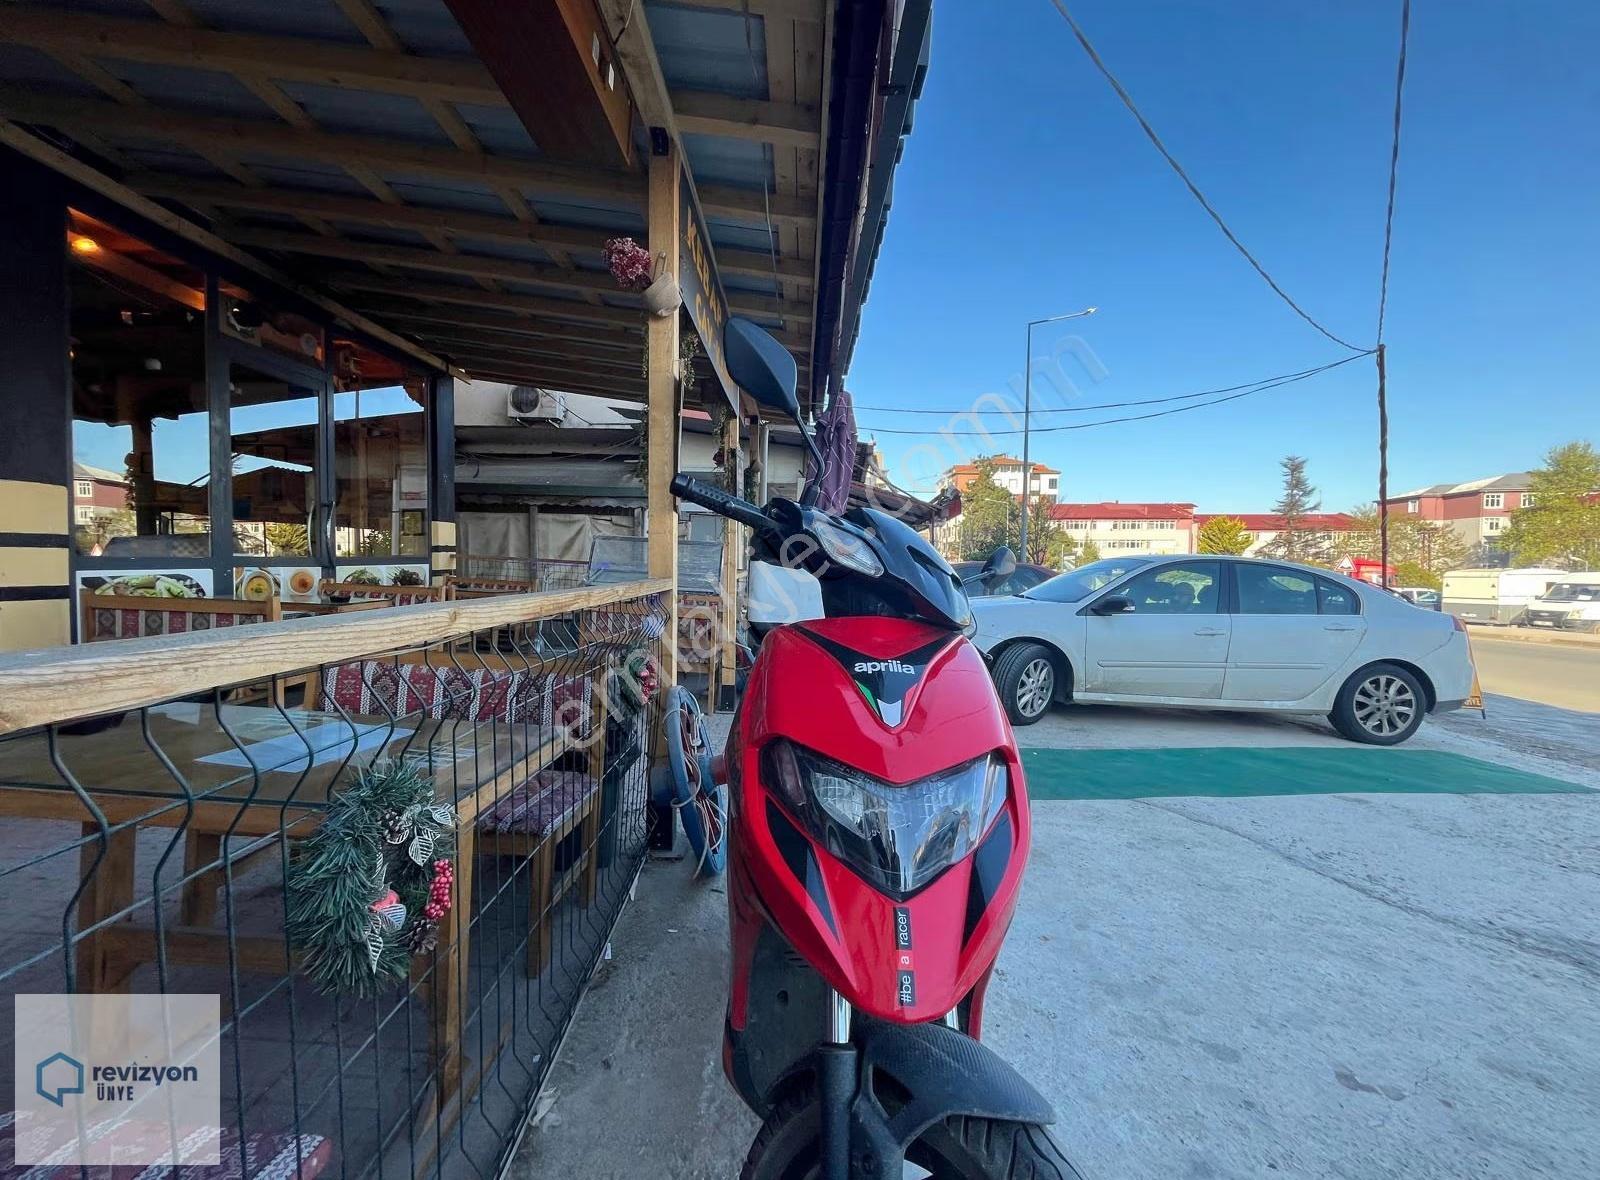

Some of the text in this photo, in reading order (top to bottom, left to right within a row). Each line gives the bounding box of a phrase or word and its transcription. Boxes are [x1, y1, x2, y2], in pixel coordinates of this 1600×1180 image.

[687, 206, 722, 326] KEBAP
[854, 660, 915, 675] aprilia
[898, 911, 912, 1003] #be a racer
